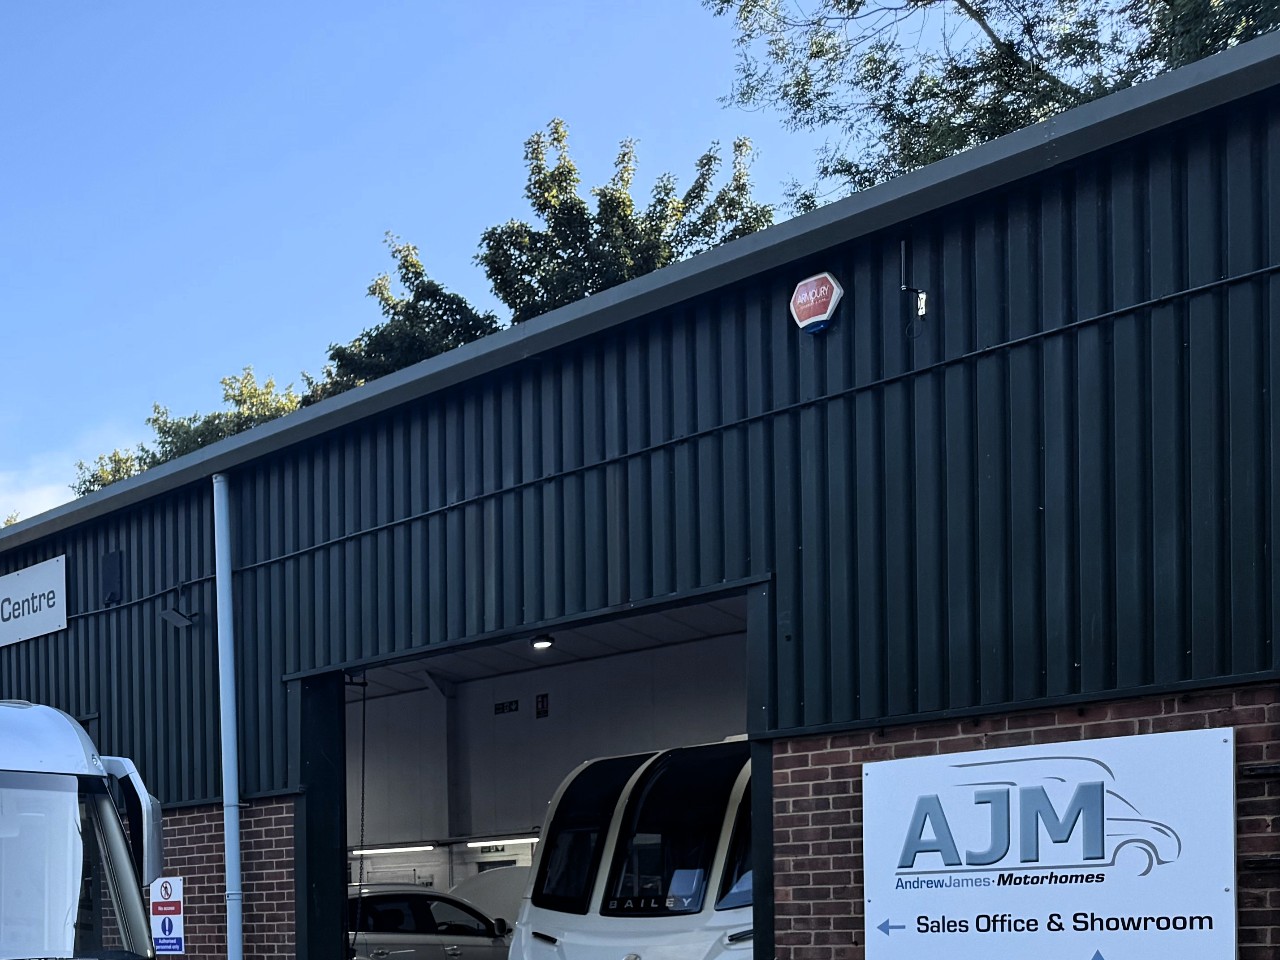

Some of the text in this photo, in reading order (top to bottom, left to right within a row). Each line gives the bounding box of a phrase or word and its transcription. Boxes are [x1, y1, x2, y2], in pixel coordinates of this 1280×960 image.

[0, 590, 56, 623] Centre
[896, 780, 1106, 869] AJM
[609, 898, 692, 909] BAILEY
[916, 911, 1214, 933] Sales Office & Showroom
